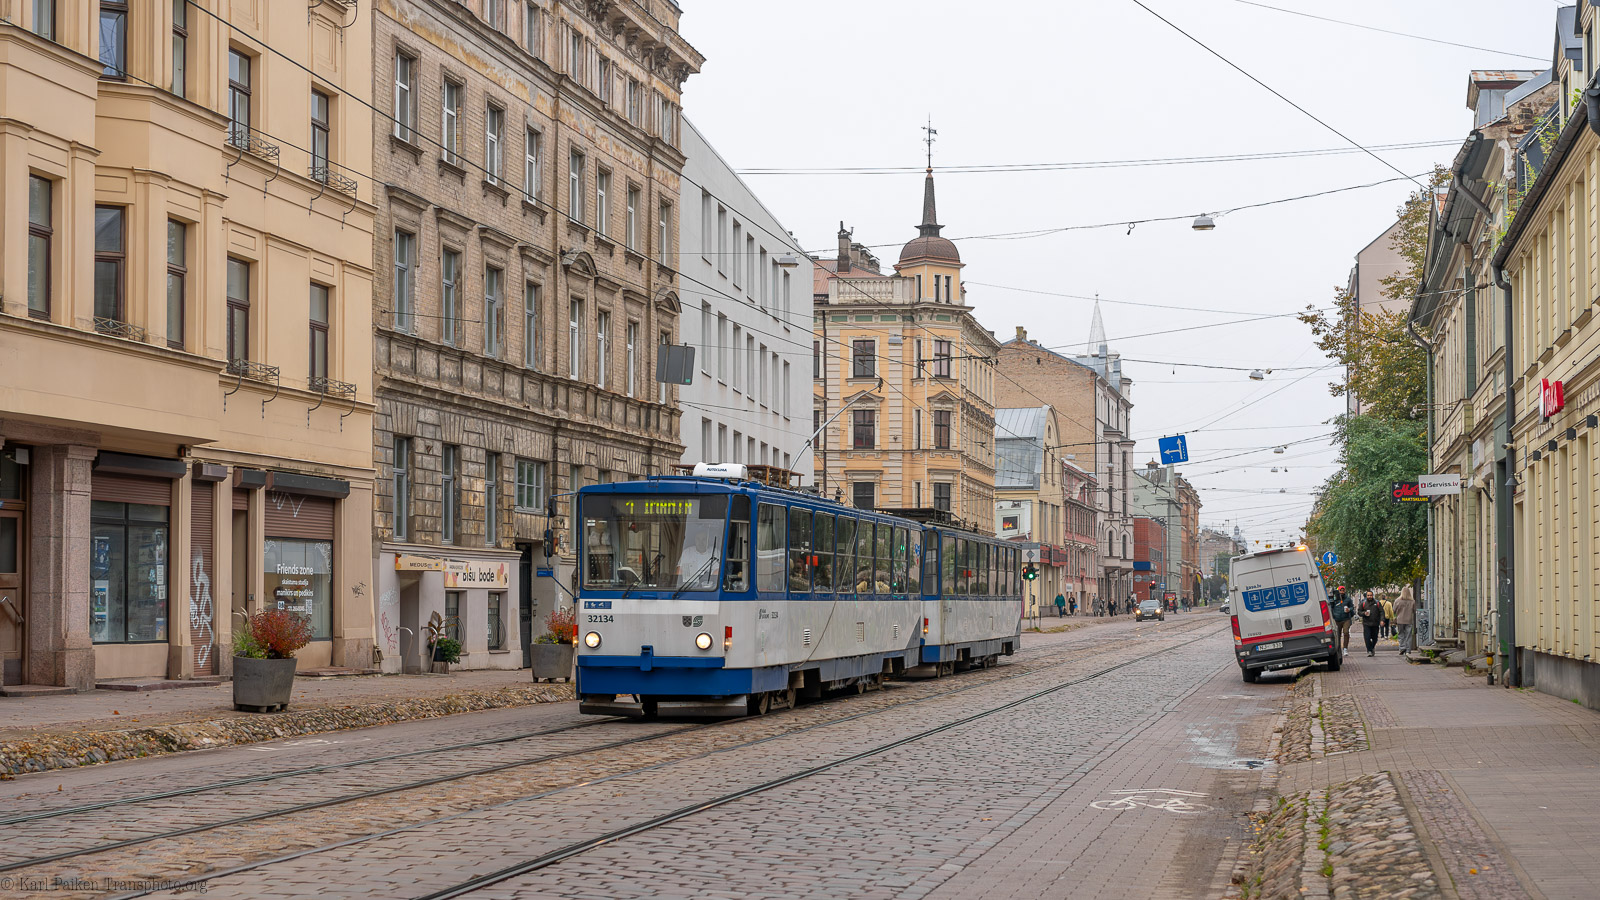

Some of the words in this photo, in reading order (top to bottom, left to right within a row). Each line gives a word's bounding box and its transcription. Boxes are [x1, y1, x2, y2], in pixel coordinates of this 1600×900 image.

[277, 563, 298, 575] Friends
[300, 566, 313, 575] zone
[479, 567, 494, 582] bode
[588, 615, 614, 623] 32134
